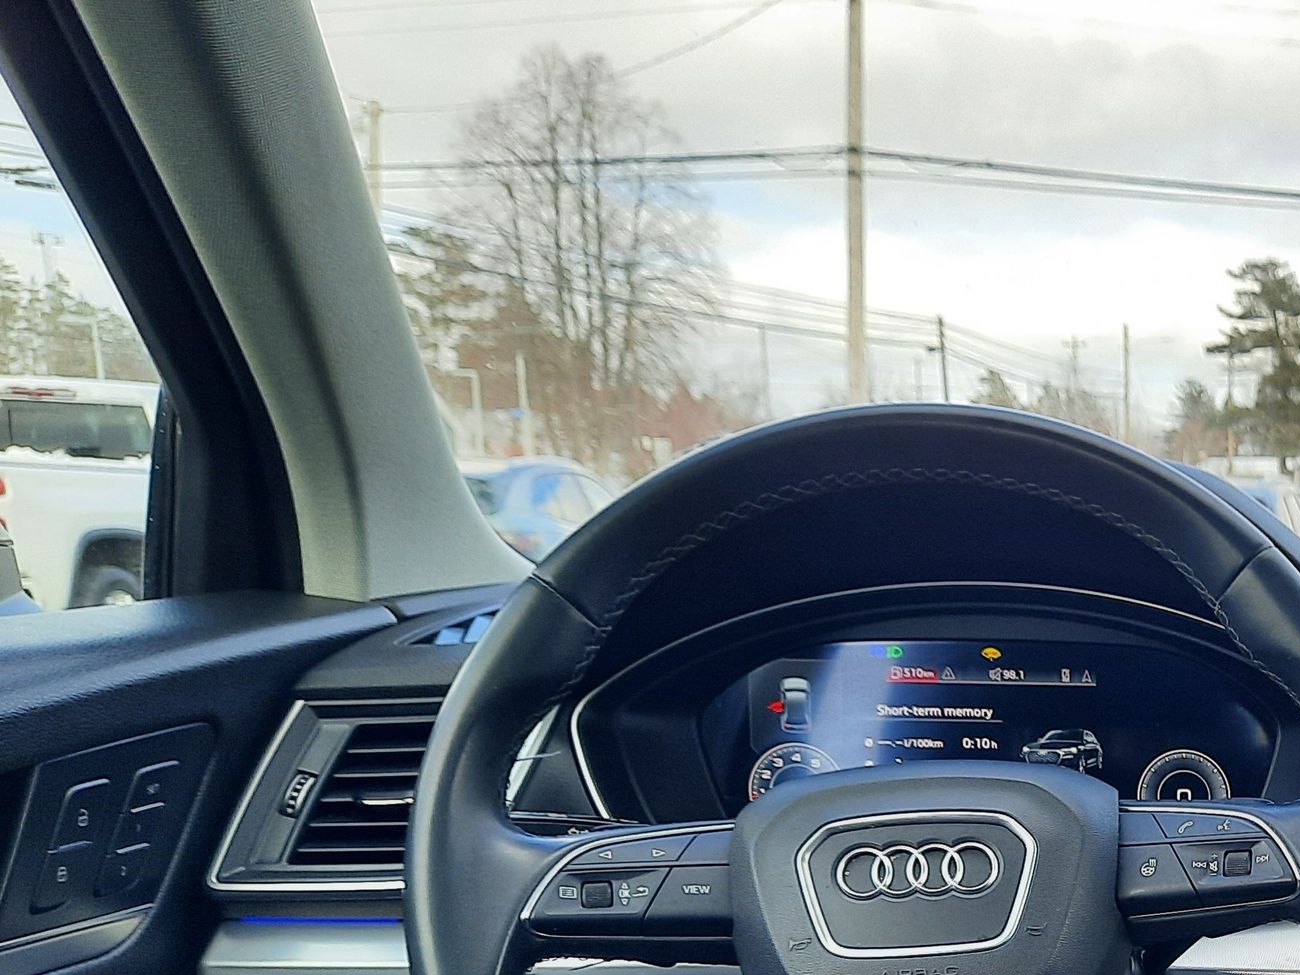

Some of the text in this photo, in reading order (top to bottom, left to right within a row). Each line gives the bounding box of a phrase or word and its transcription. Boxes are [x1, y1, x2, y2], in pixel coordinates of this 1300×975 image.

[1003, 669, 1024, 680] 98.1
[876, 703, 993, 720] Short-term memory
[618, 889, 631, 898] OK
[683, 885, 711, 894] VIEW
